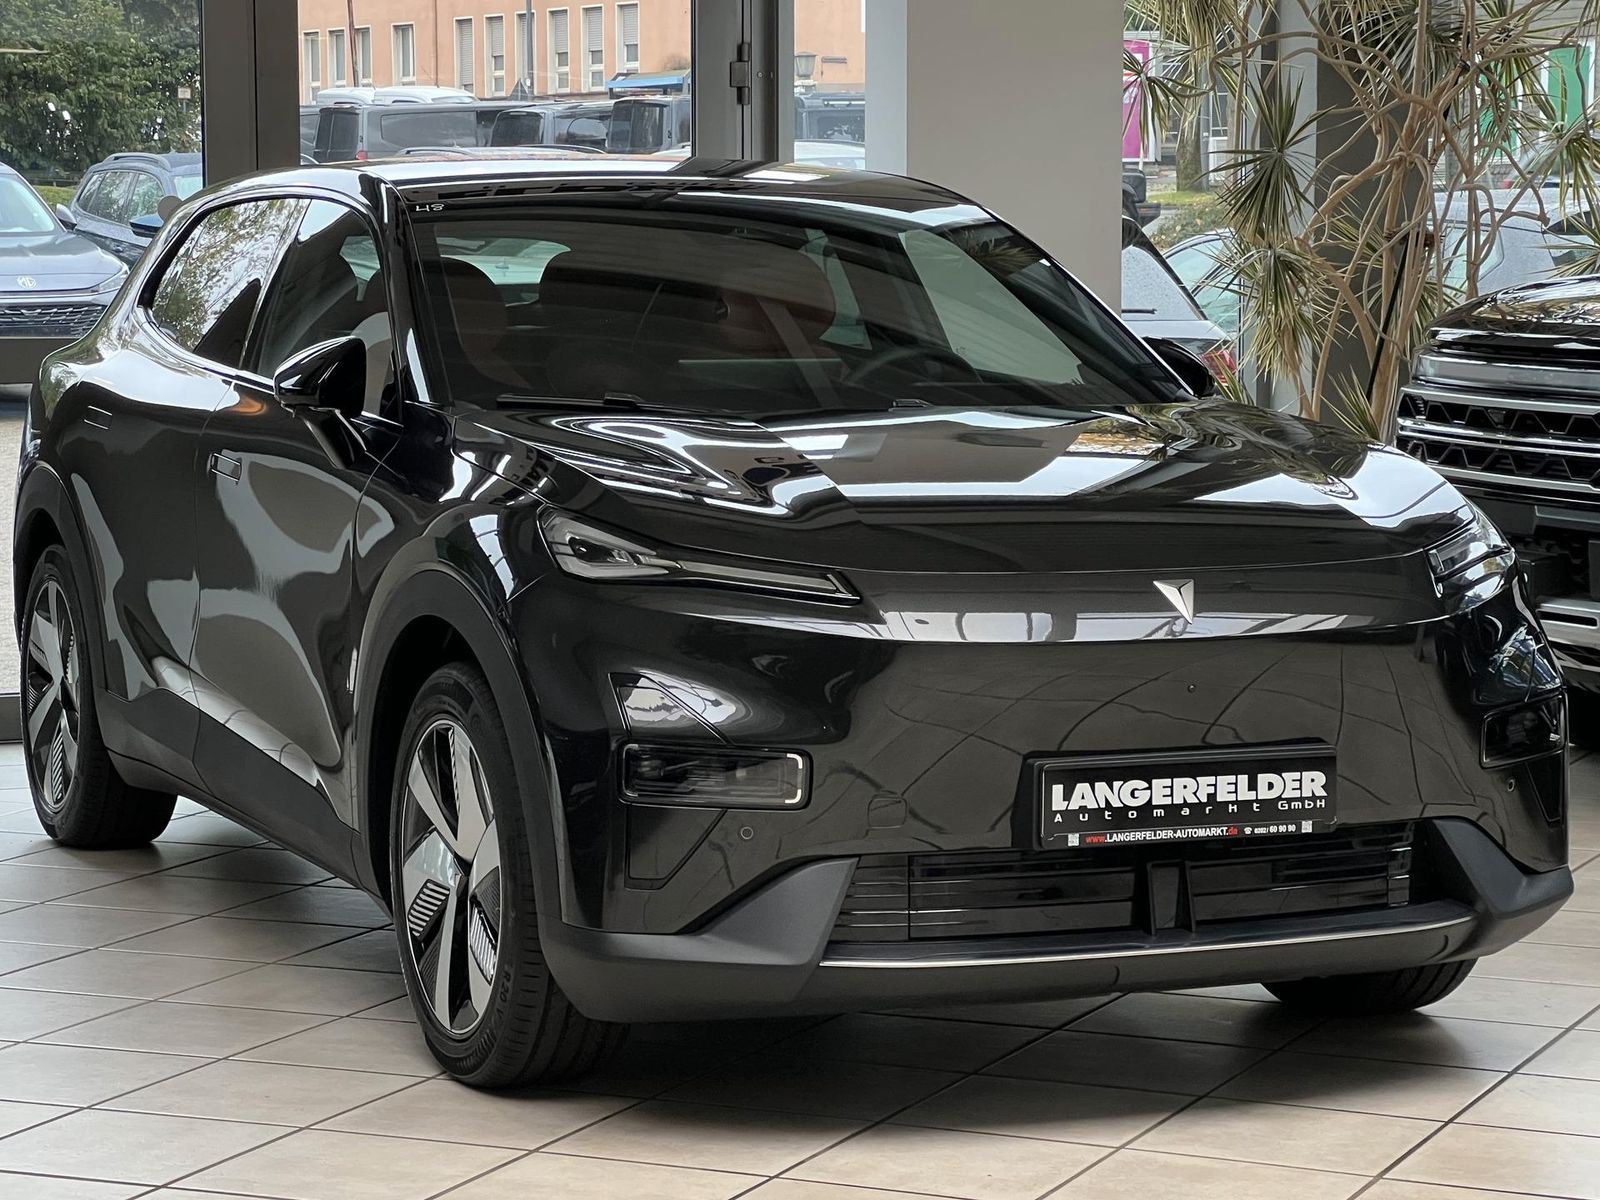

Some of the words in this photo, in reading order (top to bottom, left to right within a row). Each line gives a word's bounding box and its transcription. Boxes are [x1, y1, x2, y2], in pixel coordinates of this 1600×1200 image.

[1051, 770, 1328, 811] LANGERFELDER
[1054, 802, 1261, 823] Automarkt
[1278, 799, 1325, 810] GmbH
